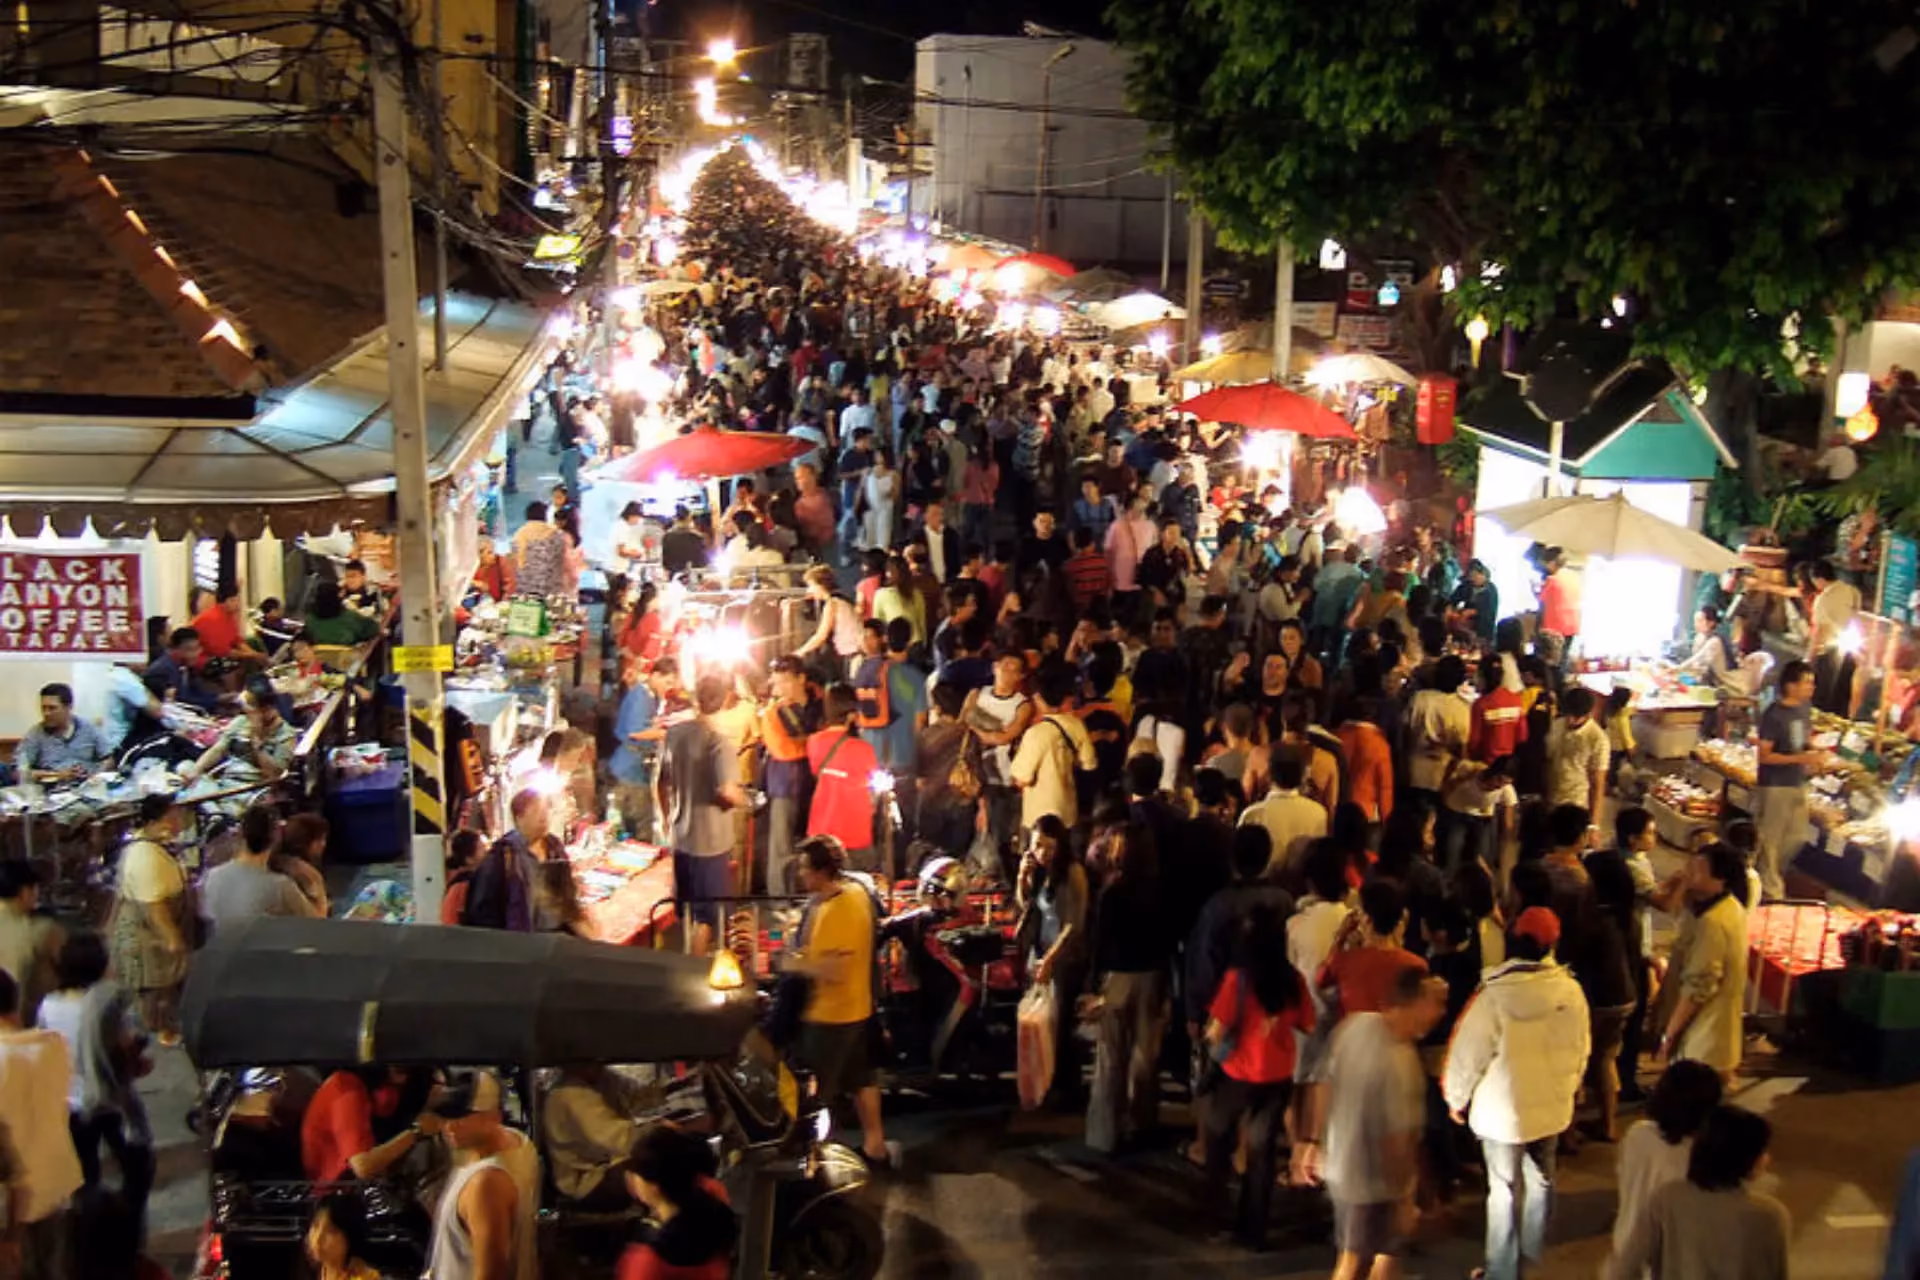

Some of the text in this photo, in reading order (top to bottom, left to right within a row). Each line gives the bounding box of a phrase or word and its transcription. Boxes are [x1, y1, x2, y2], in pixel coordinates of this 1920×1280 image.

[3, 556, 127, 581] LACK
[0, 582, 129, 608] ANYON
[1, 607, 130, 632] OFFEE
[6, 632, 110, 649] TAPAE
